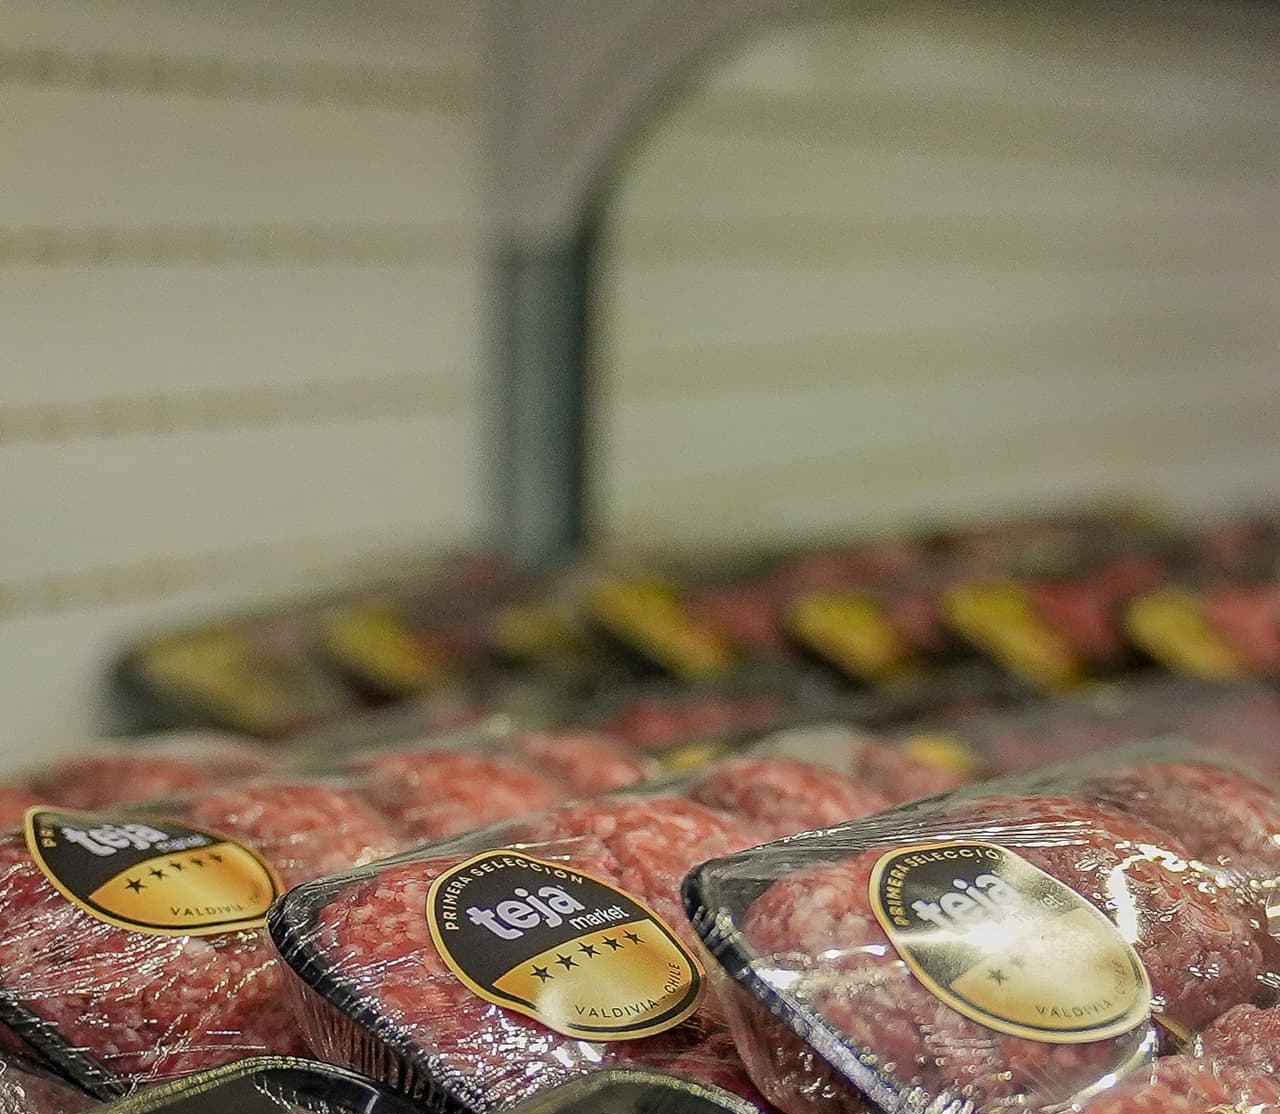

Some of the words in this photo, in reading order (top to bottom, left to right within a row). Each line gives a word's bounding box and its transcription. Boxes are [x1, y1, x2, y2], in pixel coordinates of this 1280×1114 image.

[441, 876, 473, 931] PRIMERA
[465, 884, 586, 941] teja
[568, 904, 630, 931] market
[886, 865, 911, 926] PRIMERA
[574, 997, 660, 1019] VALDIVIA
[664, 961, 682, 995] CHILE
